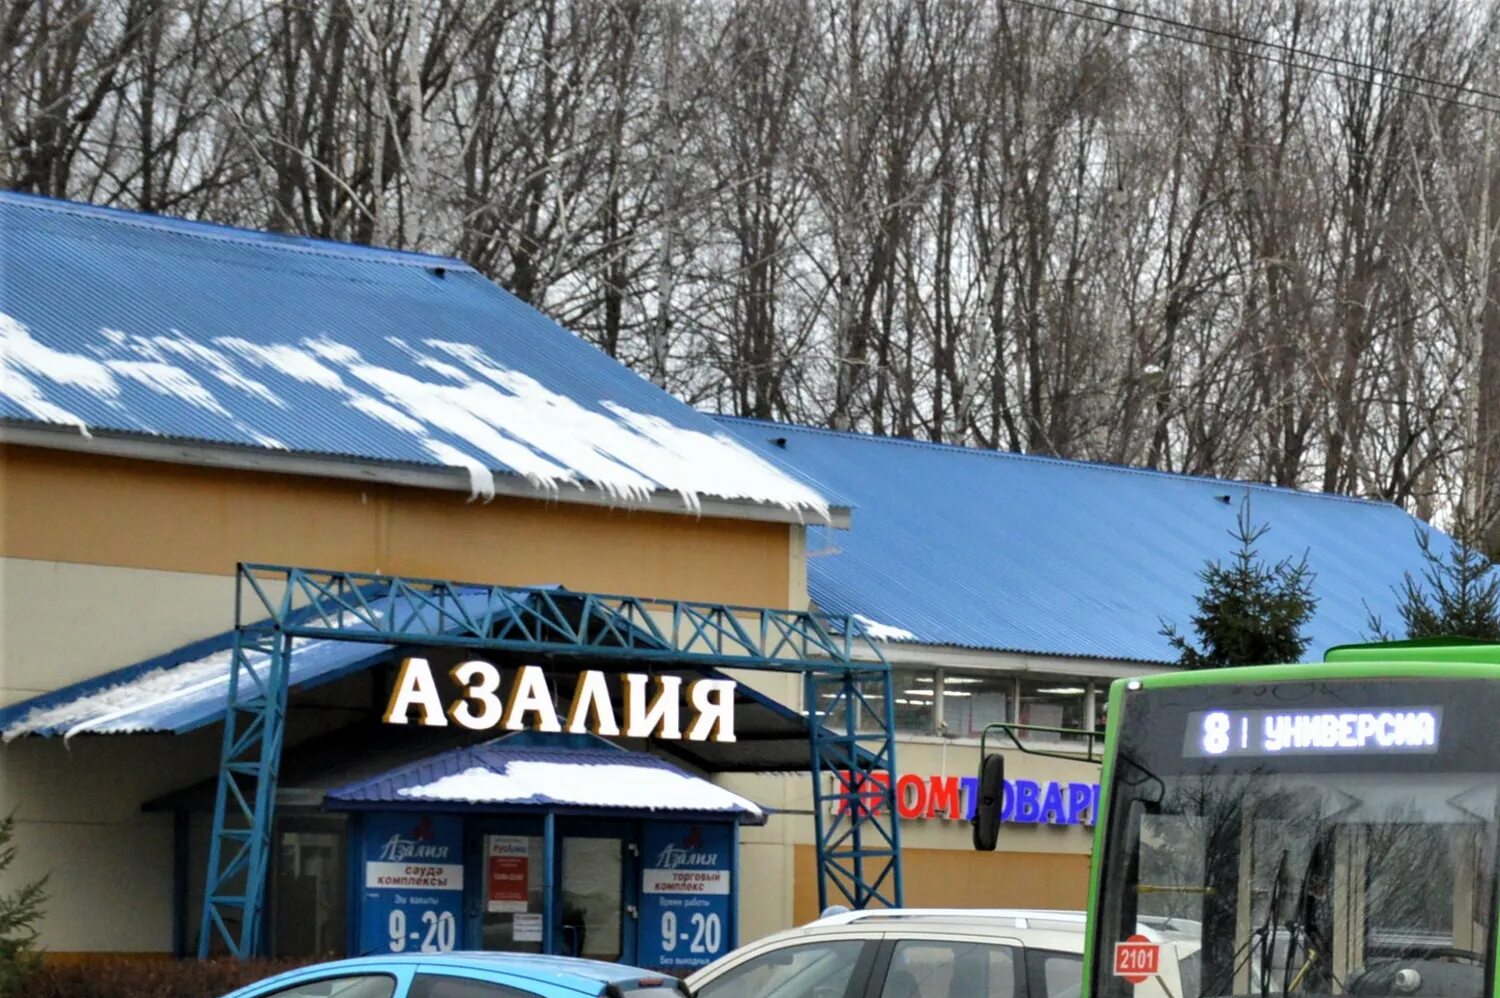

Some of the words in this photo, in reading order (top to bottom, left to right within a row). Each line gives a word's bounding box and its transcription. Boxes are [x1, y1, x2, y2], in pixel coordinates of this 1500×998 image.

[383, 657, 737, 742] АЗАЛИЯ
[1203, 711, 1230, 754] 8
[836, 770, 1101, 825] ПРОМТВАР
[380, 834, 448, 861] Азалия
[656, 843, 718, 868] Азалия
[377, 876, 448, 887] комплексы
[654, 881, 705, 892] комплекс
[1119, 949, 1154, 969] 2101
